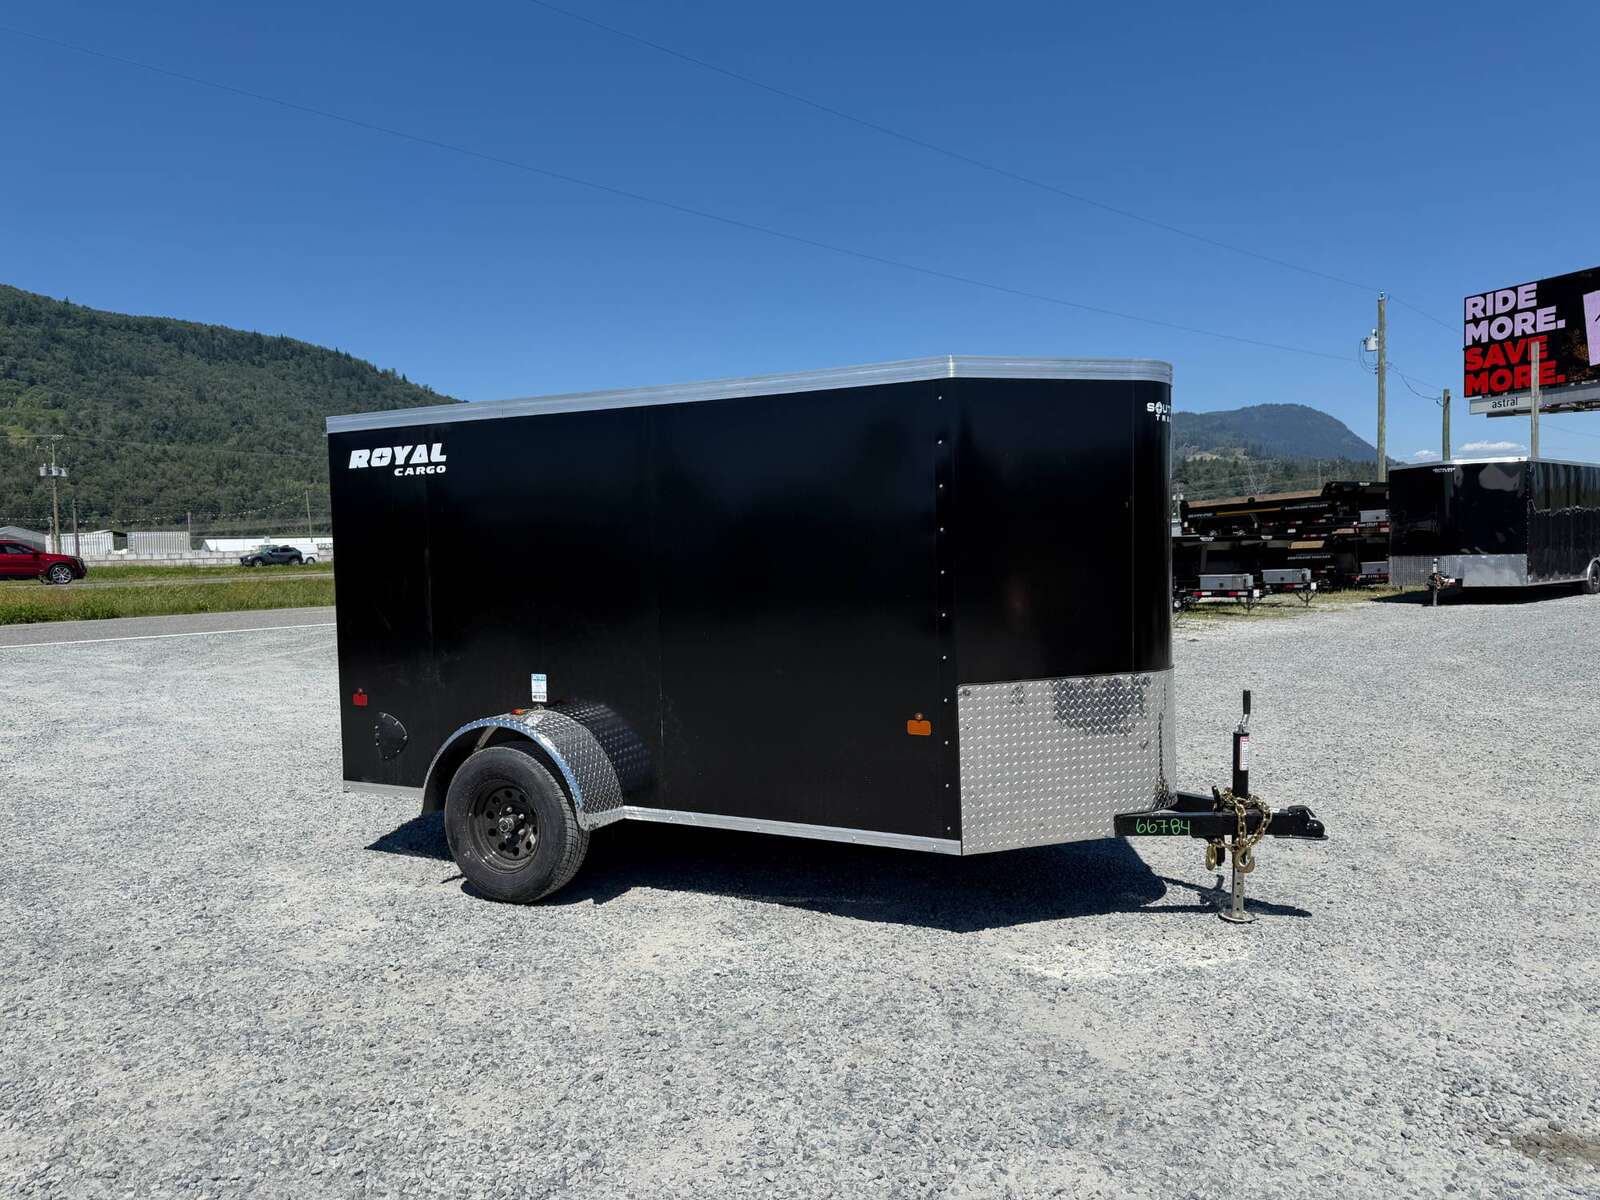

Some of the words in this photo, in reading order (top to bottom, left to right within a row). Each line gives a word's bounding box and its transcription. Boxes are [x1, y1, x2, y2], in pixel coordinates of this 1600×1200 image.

[1465, 283, 1537, 320] RIDE
[1465, 306, 1566, 346] MORE.
[1466, 335, 1548, 371] SAVE
[1466, 360, 1566, 396] MORE.
[1491, 397, 1518, 409] astral
[348, 443, 447, 469] ROYAL
[393, 465, 446, 476] CARGO
[1136, 818, 1191, 835] 66784
